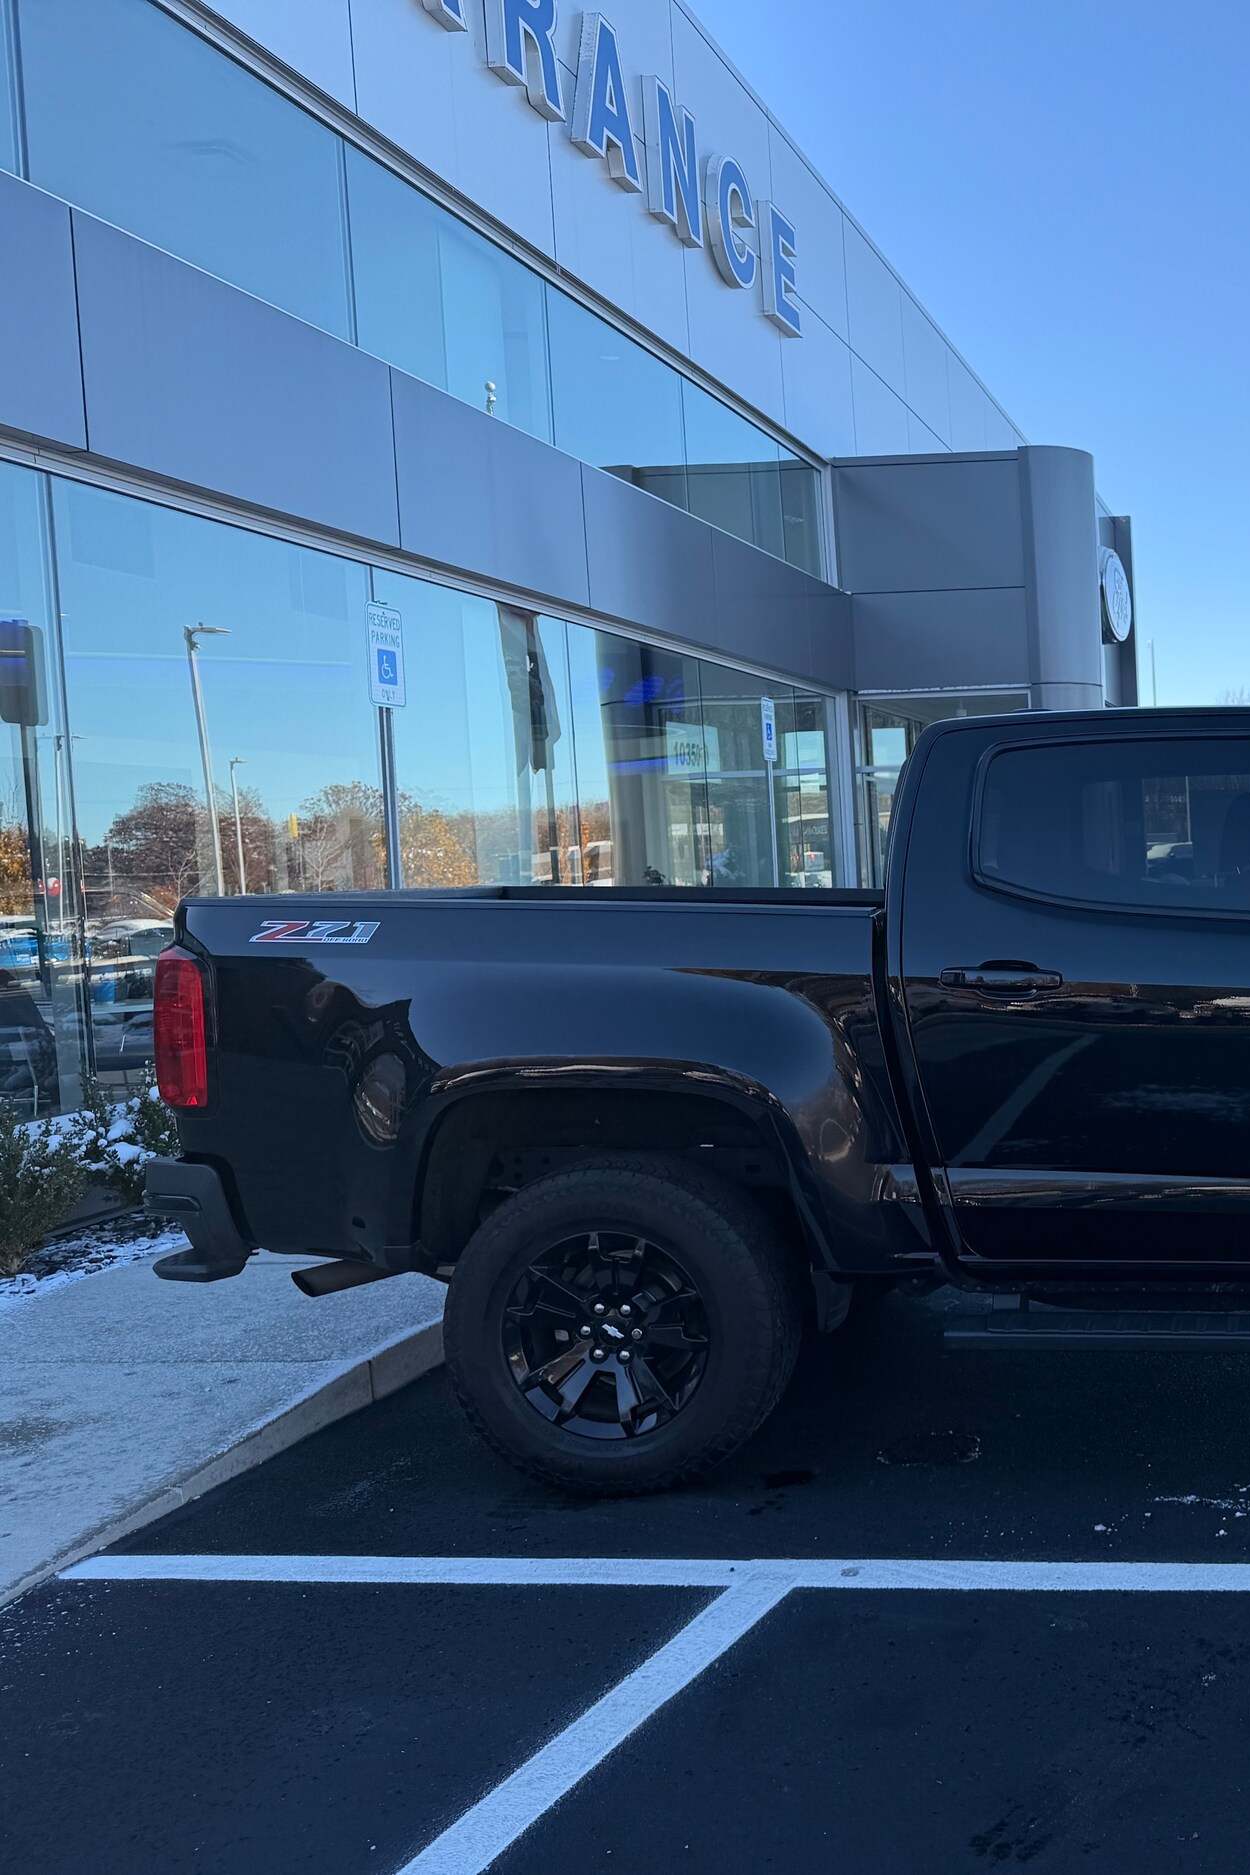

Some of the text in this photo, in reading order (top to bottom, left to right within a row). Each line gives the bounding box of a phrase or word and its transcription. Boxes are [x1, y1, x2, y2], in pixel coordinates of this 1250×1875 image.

[423, 0, 804, 339] RANCE
[369, 612, 400, 631] RESERVED
[371, 630, 400, 648] PARKING
[381, 688, 396, 700] ONLY
[248, 920, 381, 943] Z71
